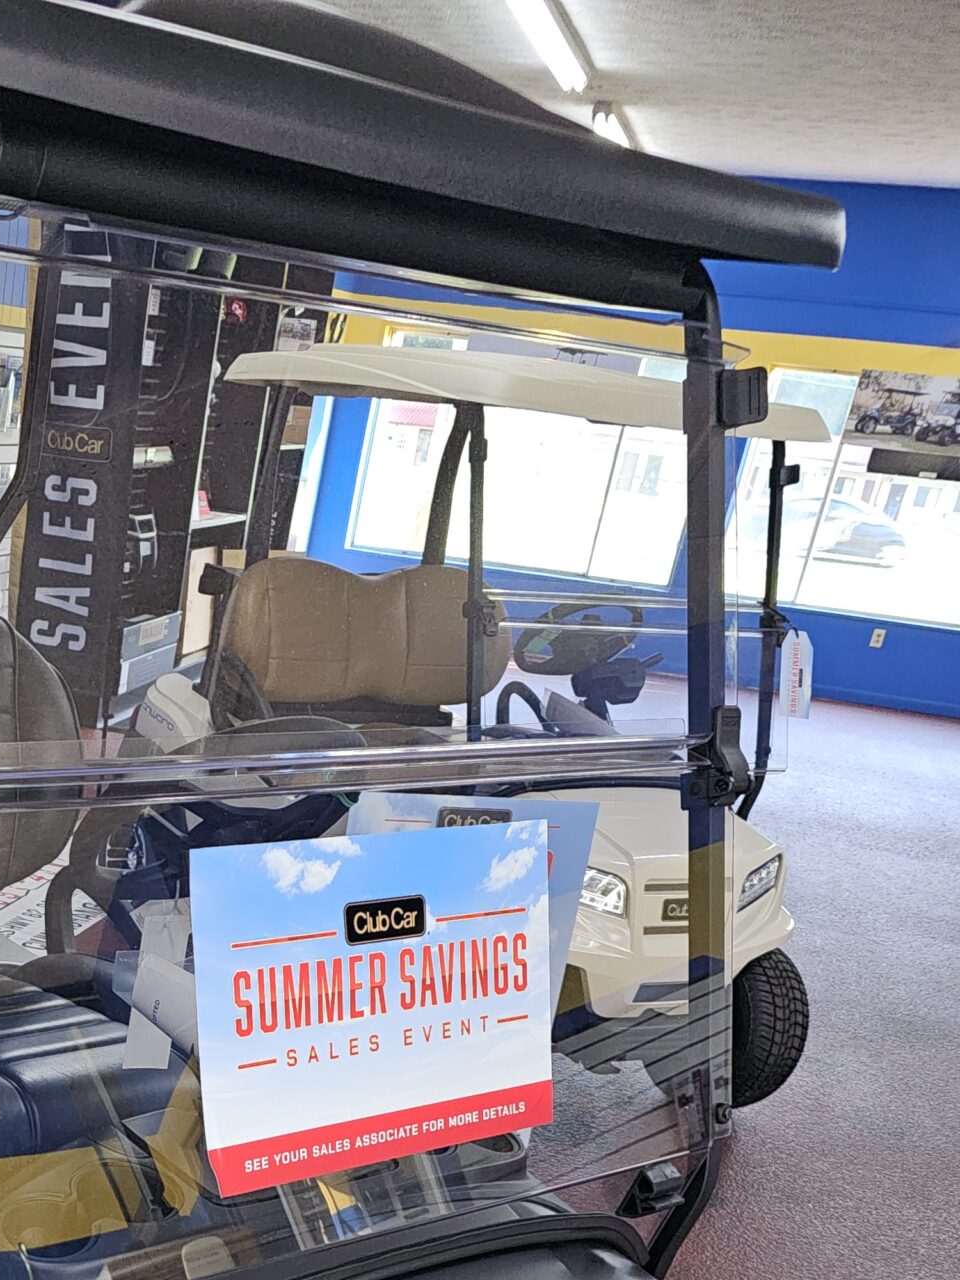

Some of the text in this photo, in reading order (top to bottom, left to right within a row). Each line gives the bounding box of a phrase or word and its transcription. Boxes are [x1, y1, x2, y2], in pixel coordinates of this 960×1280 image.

[29, 224, 112, 651] SALES EVEN
[74, 432, 105, 455] Car
[353, 907, 418, 934] Club Car
[232, 933, 528, 1037] SUMMER SAVINGS
[286, 1016, 489, 1067] SALES EVENT
[244, 1101, 526, 1173] SEE YOUR SALES ASSOCIATE FOR MORE DETAILS
